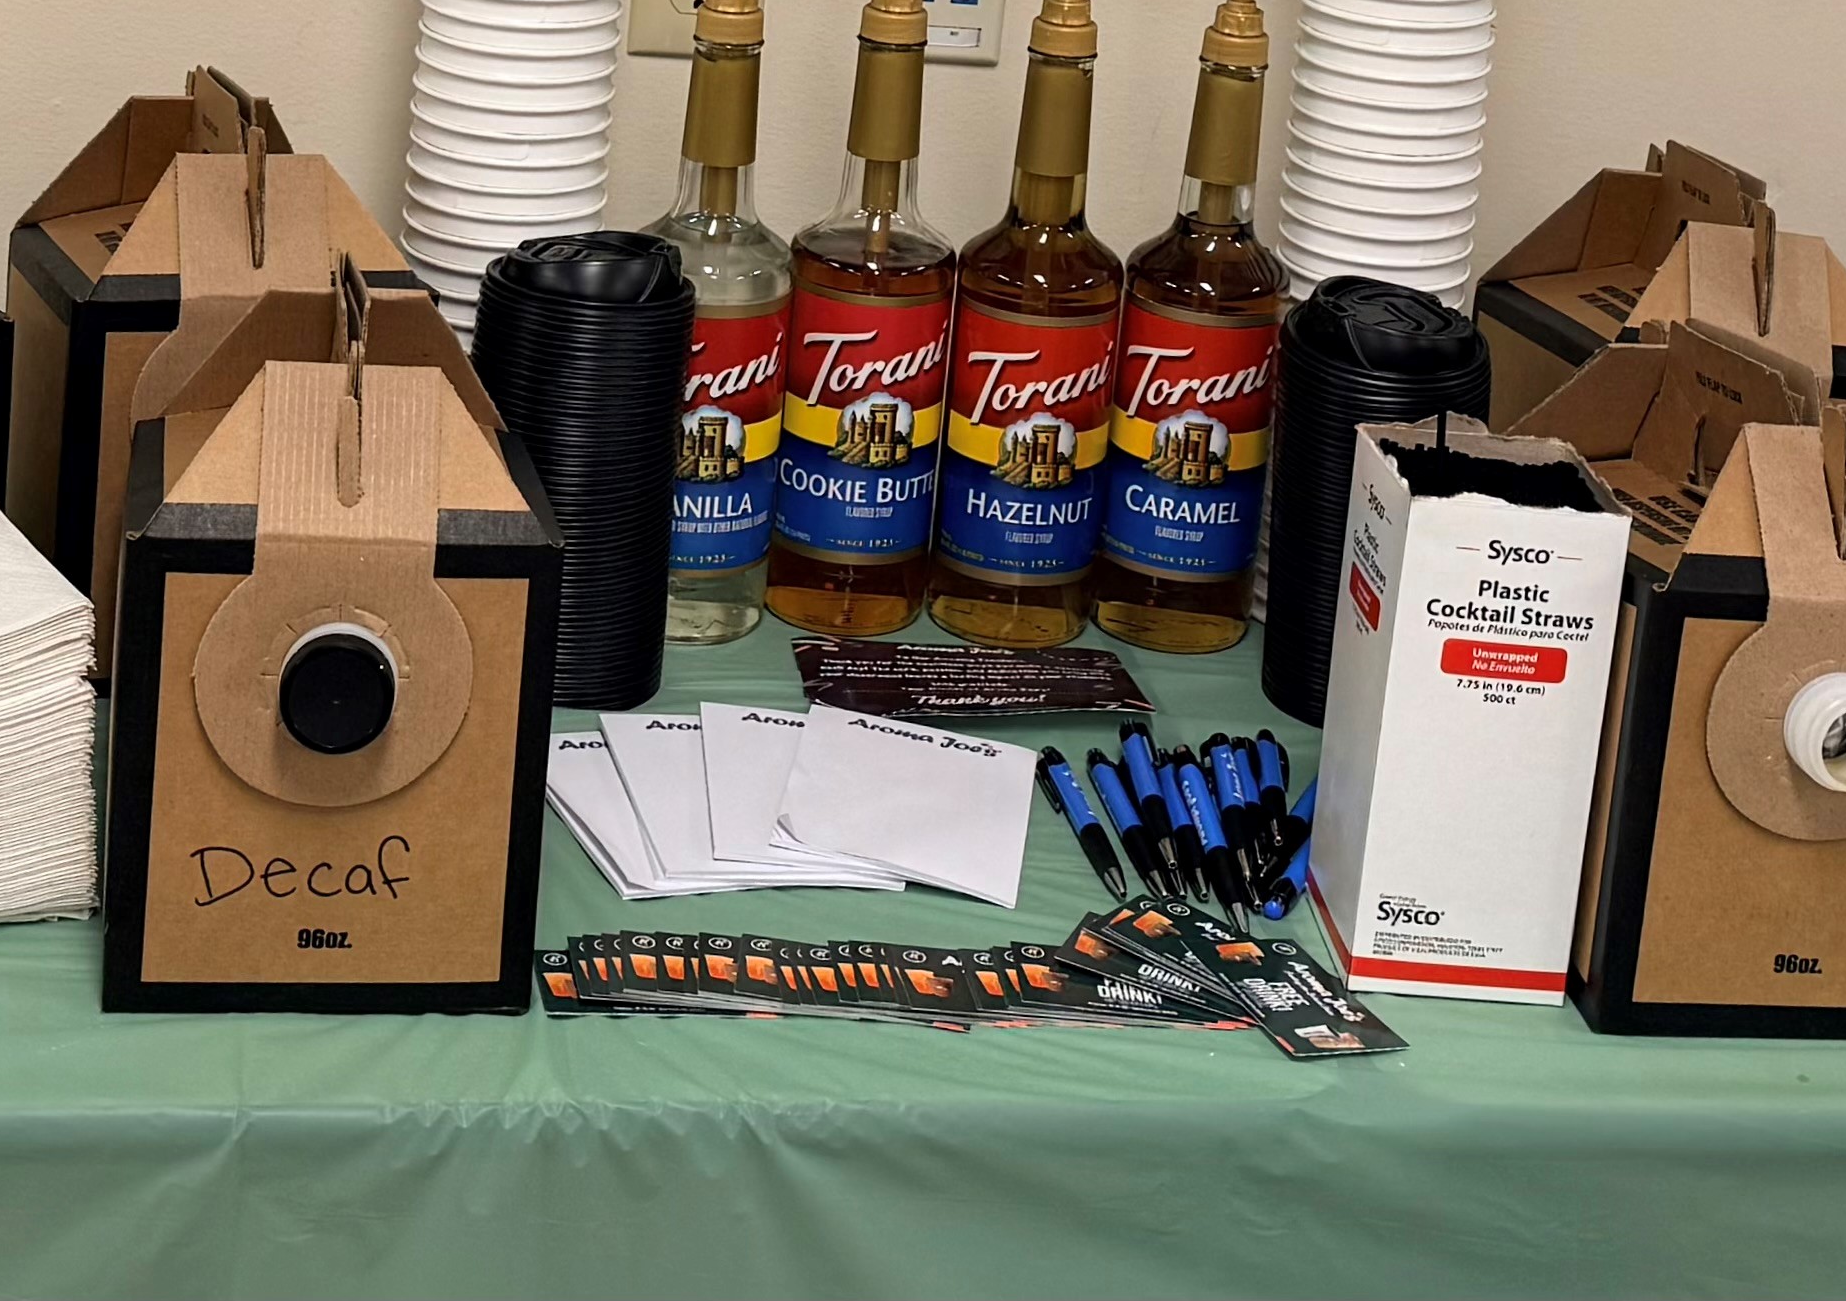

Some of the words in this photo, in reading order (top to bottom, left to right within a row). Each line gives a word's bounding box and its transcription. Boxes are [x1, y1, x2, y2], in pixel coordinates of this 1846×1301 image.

[803, 320, 949, 408] Torani
[968, 340, 1114, 426] Torani
[1126, 344, 1274, 419] Torani
[779, 457, 867, 503] COOKIE
[966, 488, 1093, 526] HAZELNUT
[1125, 484, 1241, 525] CARAMEL
[1487, 539, 1552, 566] Sysco
[1478, 579, 1551, 603] Plastic
[1426, 598, 1517, 624] Cocktail
[1520, 608, 1595, 630] Straws
[1427, 618, 1470, 632] Popotes
[1472, 623, 1485, 634] de
[1529, 630, 1555, 640] para
[1471, 647, 1539, 664] Unwrapped
[1471, 659, 1489, 670] No
[1489, 660, 1537, 675] Envuelto
[1456, 678, 1480, 690] 7.75
[1482, 680, 1493, 691] in
[1525, 684, 1546, 696] cm)
[1482, 692, 1504, 704] 500
[1505, 696, 1517, 706] ct
[847, 717, 934, 743] Aroma
[190, 835, 410, 907] Decaf
[1376, 901, 1441, 927] Sysco
[297, 928, 353, 950] 96oz.
[1772, 953, 1823, 975] 96oz.
